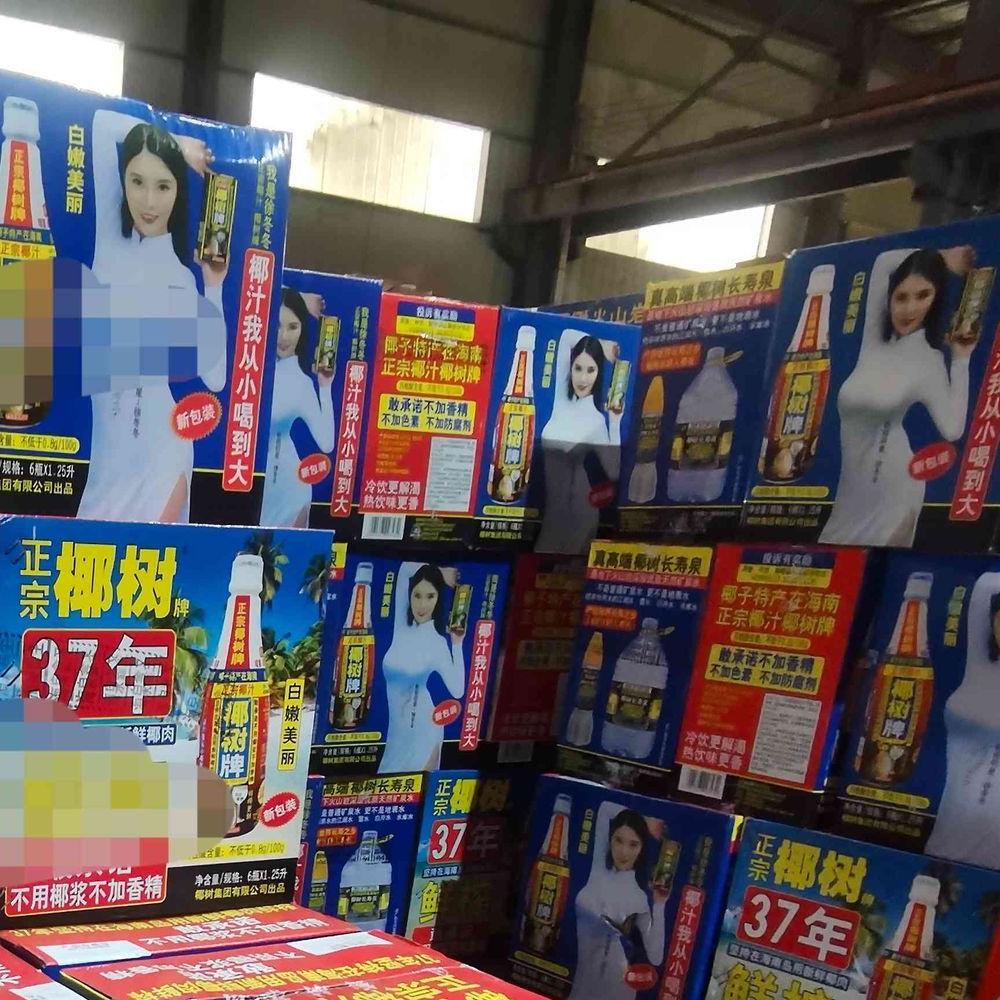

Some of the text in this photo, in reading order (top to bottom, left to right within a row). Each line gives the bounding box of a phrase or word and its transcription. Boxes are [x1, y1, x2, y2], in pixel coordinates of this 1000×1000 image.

[65, 125, 85, 214] 白嫩美丽
[228, 253, 271, 485] 椰汁我从小喝到大
[381, 358, 481, 384] 正宗椰汁椰树牌
[175, 401, 217, 431] 新包装
[334, 365, 365, 513] 椰汁我从小喝到大
[20, 539, 52, 619] 正宗
[31, 634, 168, 714] 37年
[218, 701, 249, 778] 椰树牌
[280, 683, 300, 766] 白嫩美丽
[262, 798, 298, 822] 新包装
[434, 780, 452, 816] 正宗
[10, 874, 164, 912] 不用椰浆不加香精
[195, 882, 285, 900] 椰树集团有限公司出品
[748, 835, 774, 880] 正宗
[742, 892, 852, 963] 37年
